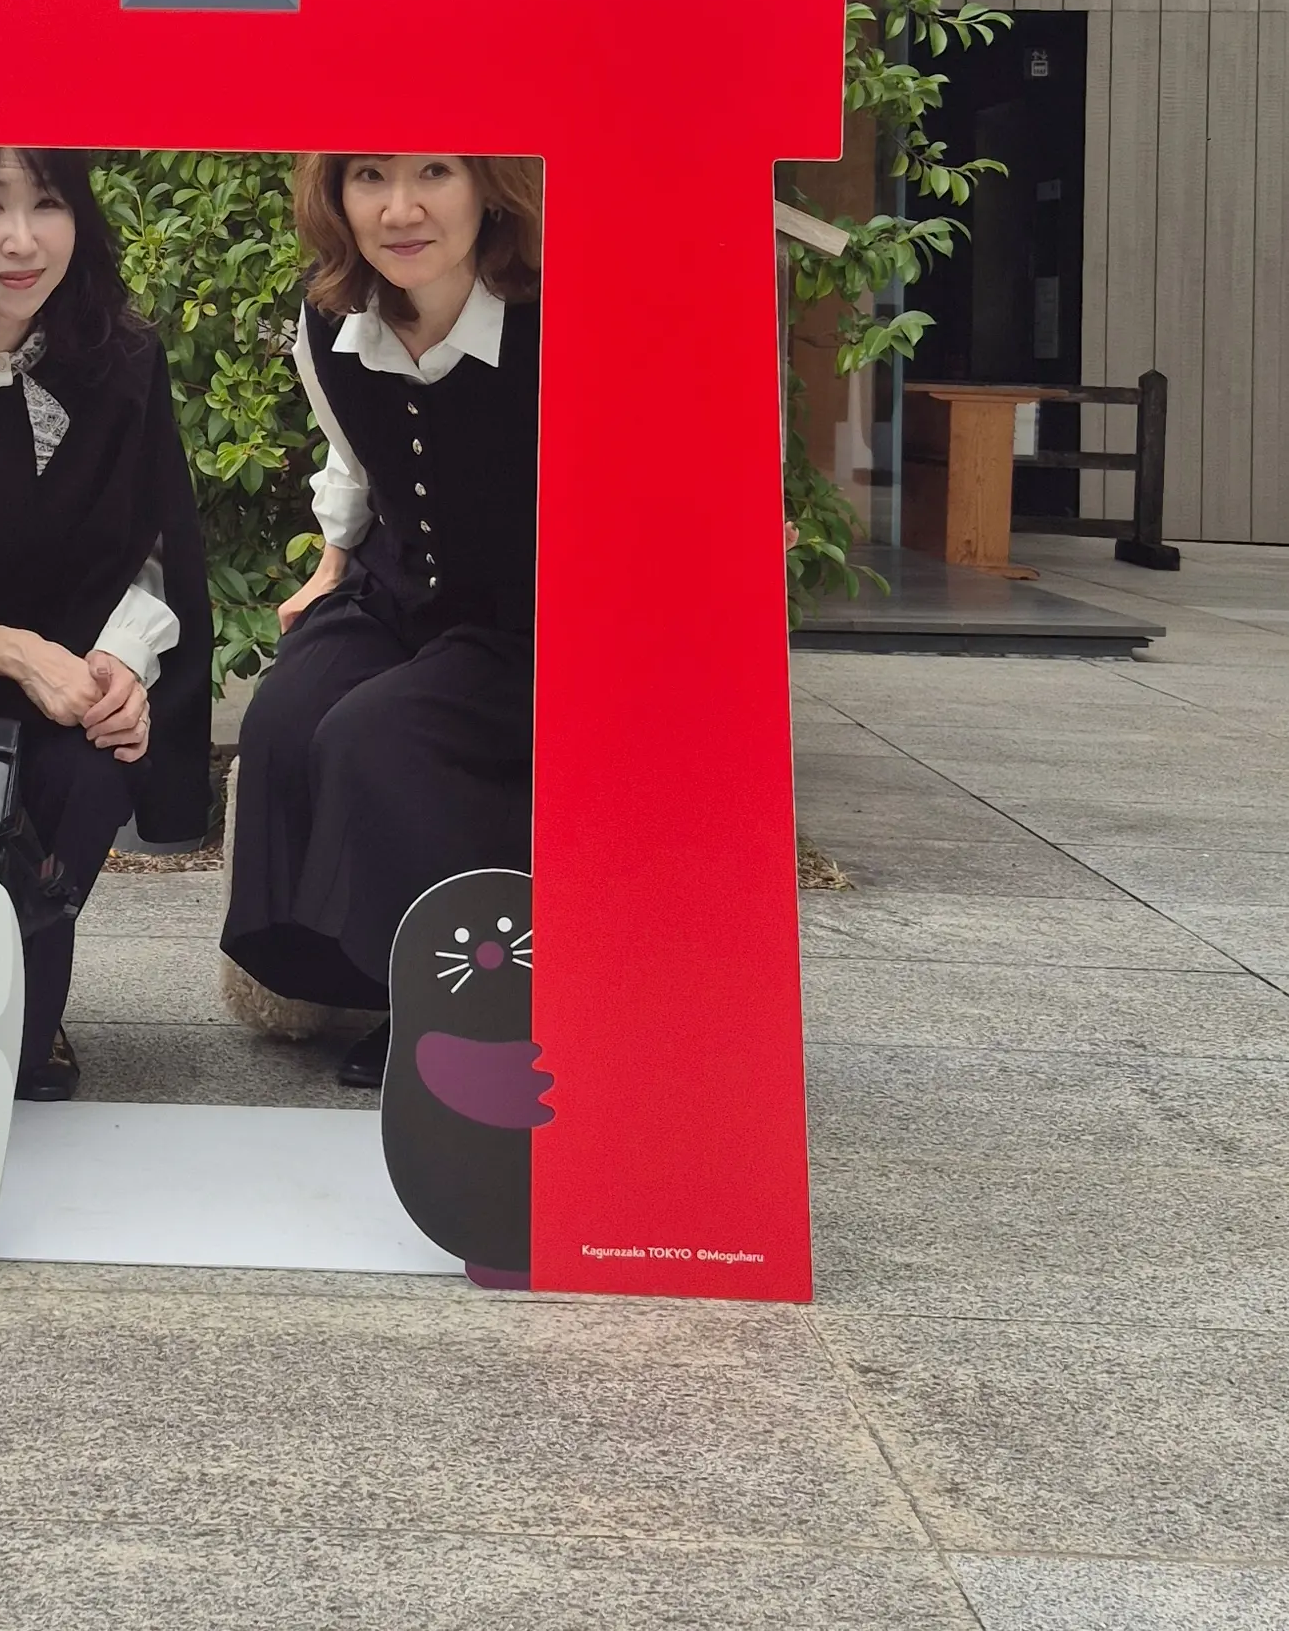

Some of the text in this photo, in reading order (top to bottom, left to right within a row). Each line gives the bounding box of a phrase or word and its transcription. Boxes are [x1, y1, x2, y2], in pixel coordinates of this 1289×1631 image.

[581, 1245, 764, 1264] Kagurazaka TOKYO ©Moguharu
